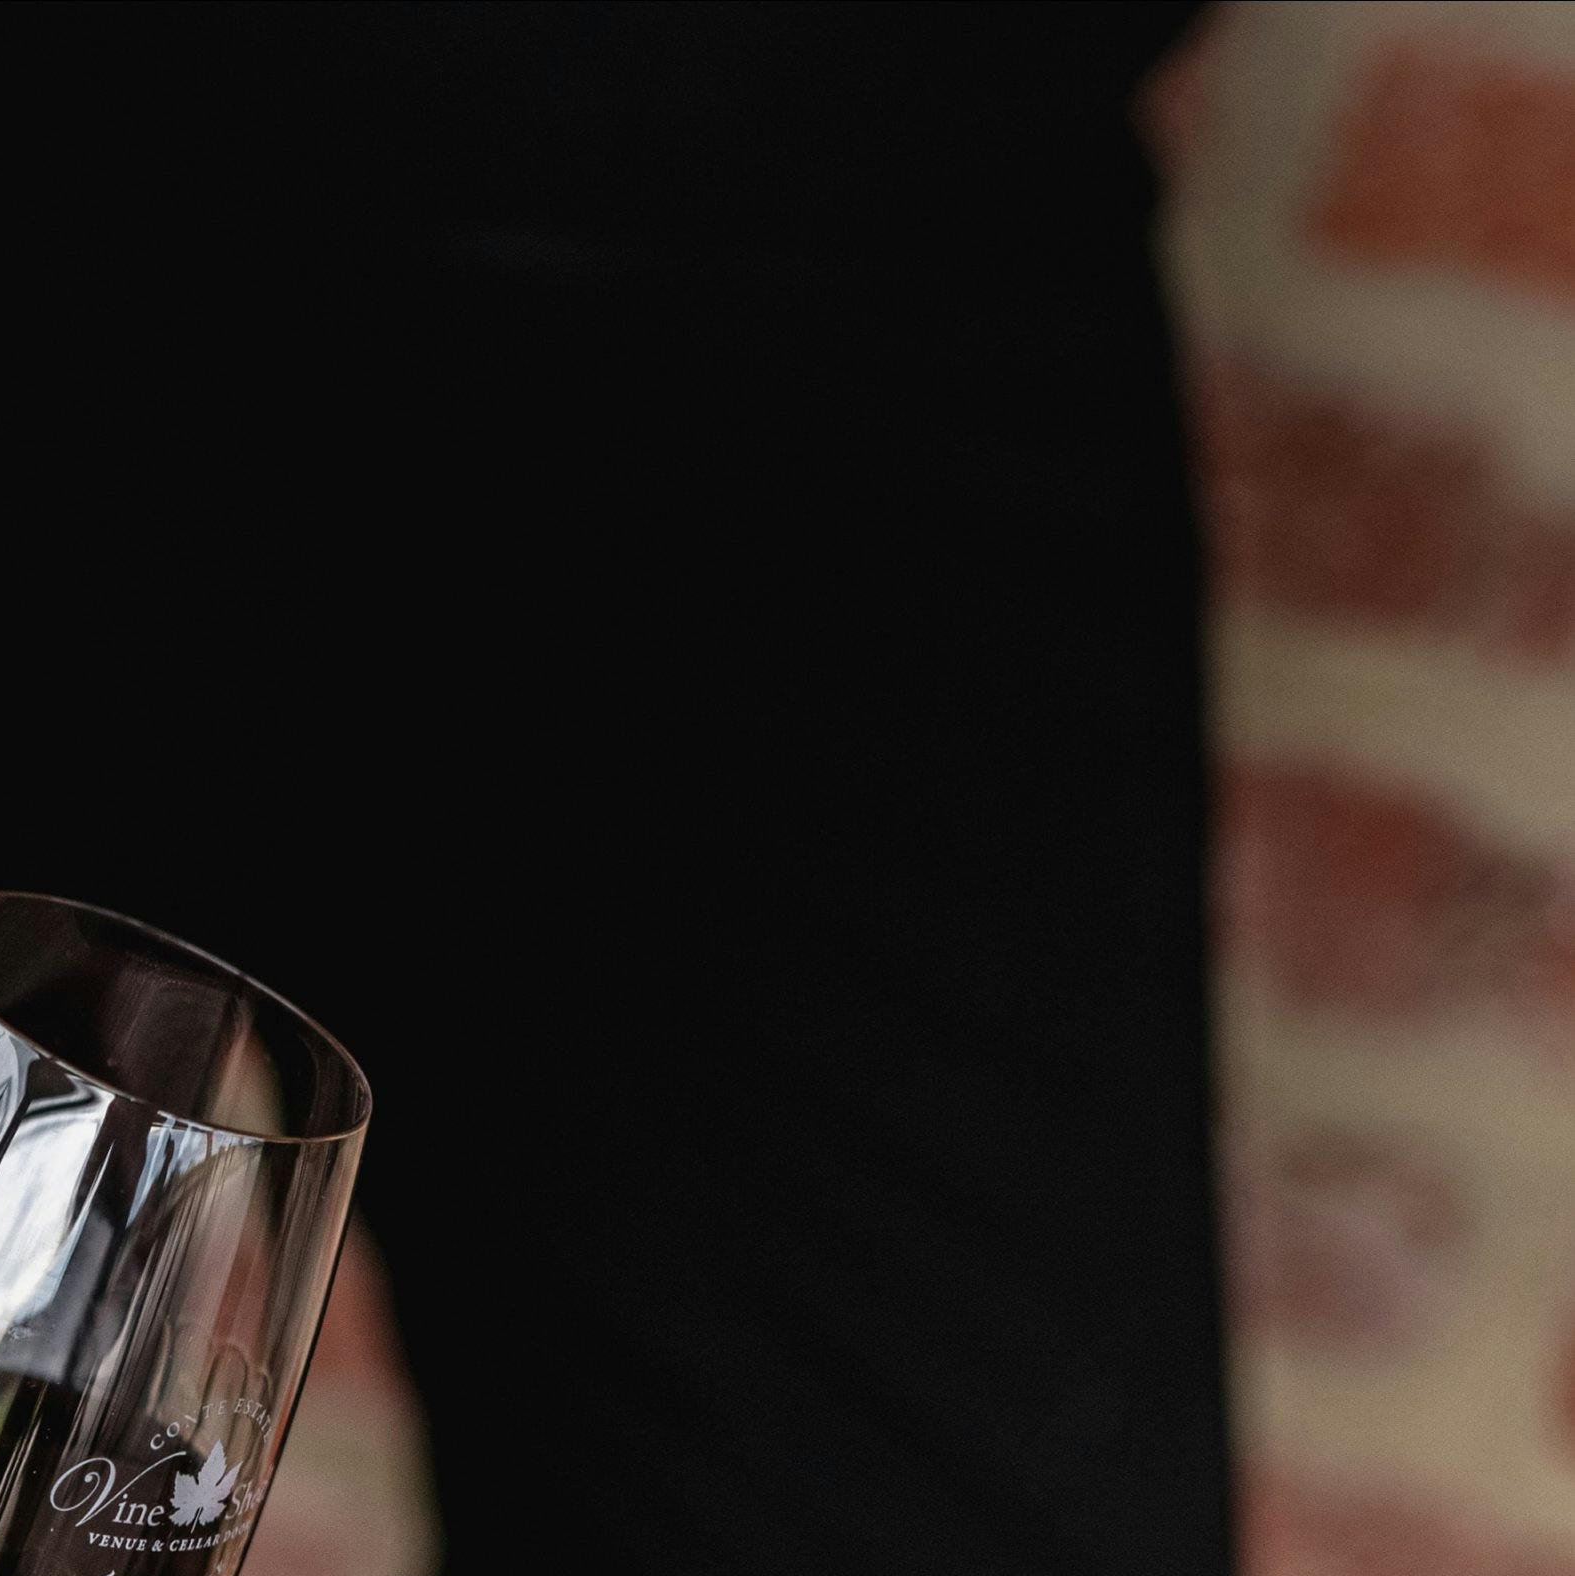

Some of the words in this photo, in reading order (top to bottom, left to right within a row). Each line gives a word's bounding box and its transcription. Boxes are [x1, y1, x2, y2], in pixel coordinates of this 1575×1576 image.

[49, 1450, 187, 1528] Vine
[87, 1532, 147, 1552] VENUE
[151, 1540, 164, 1552] &
[169, 1533, 220, 1553] CELLAR
